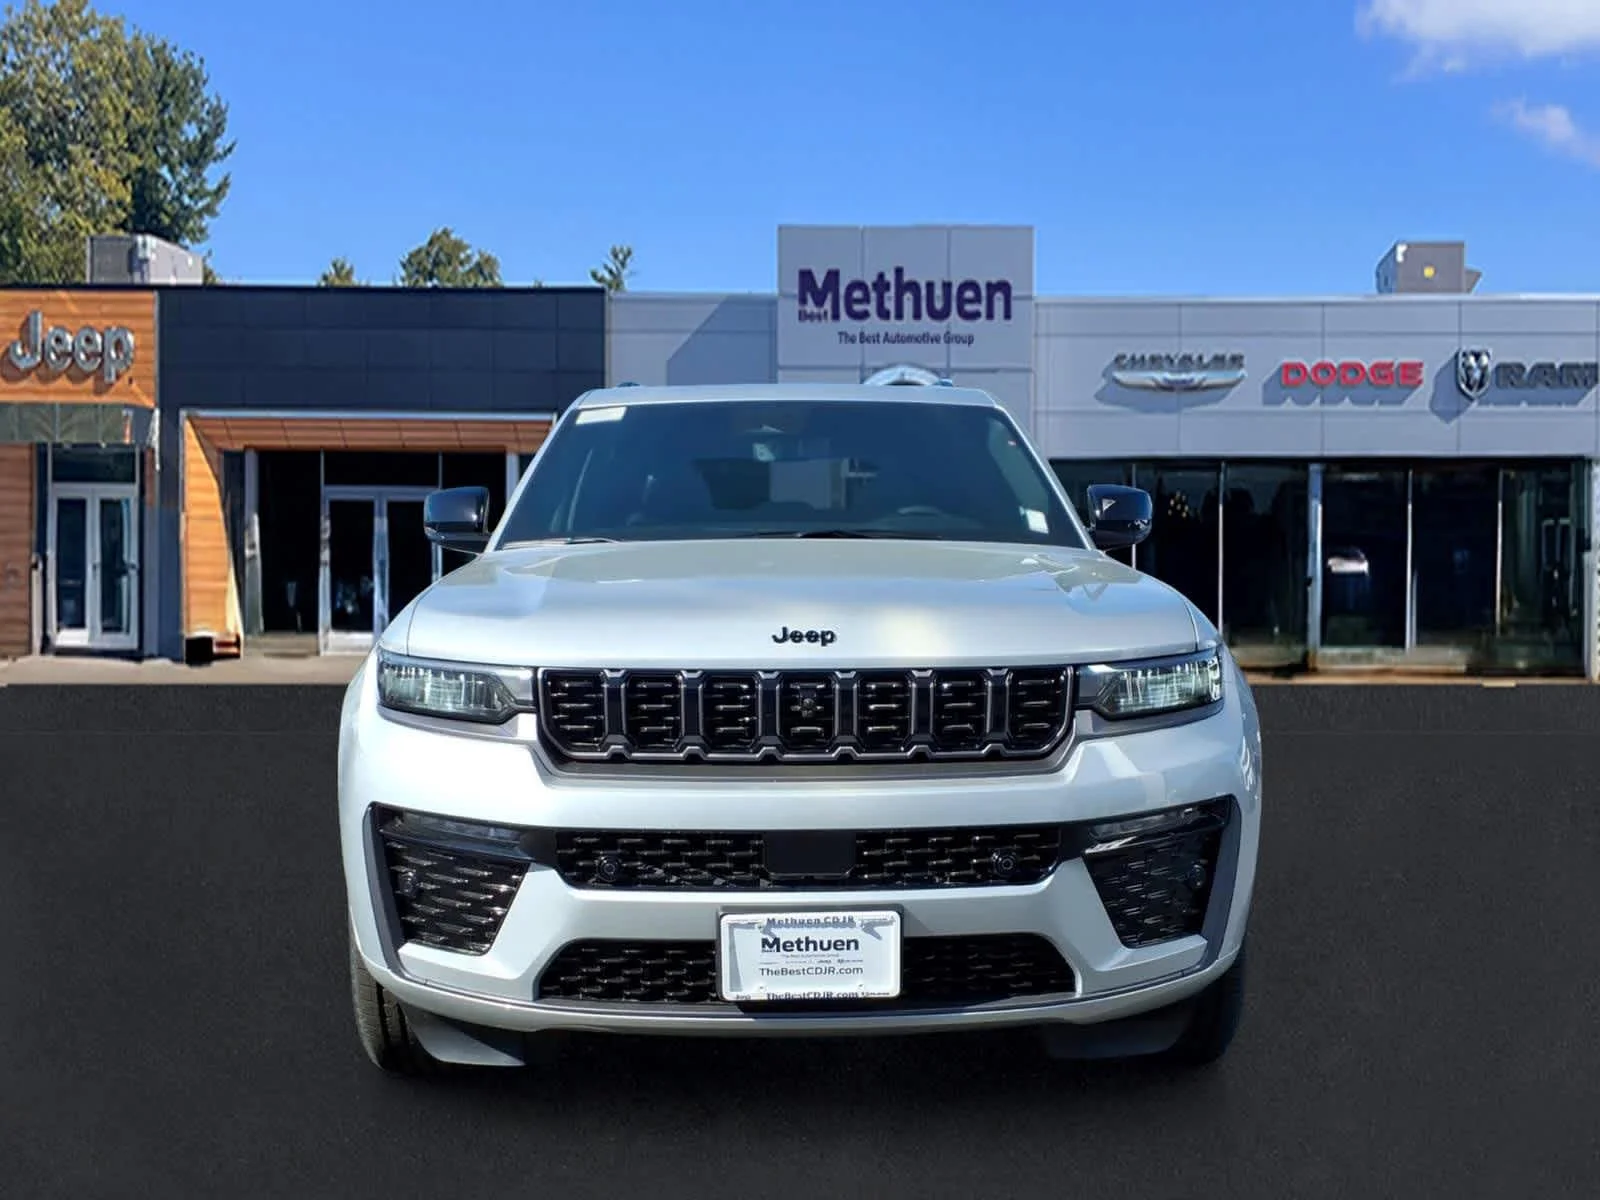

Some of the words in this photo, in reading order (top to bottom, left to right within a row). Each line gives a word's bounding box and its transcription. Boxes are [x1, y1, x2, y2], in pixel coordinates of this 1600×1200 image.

[798, 266, 1012, 321] Methuen
[9, 309, 135, 384] Jeep
[838, 331, 857, 345] The
[859, 331, 881, 345] Best
[883, 331, 941, 345] Automotive
[943, 331, 974, 347] Group
[1281, 360, 1424, 386] DODGE
[1495, 361, 1599, 389] RAM
[771, 626, 837, 647] Jeep
[766, 917, 821, 926] Methuen
[823, 915, 856, 925] CDJR
[761, 936, 860, 953] Methuen
[759, 966, 864, 977] TheBestCDJR.com
